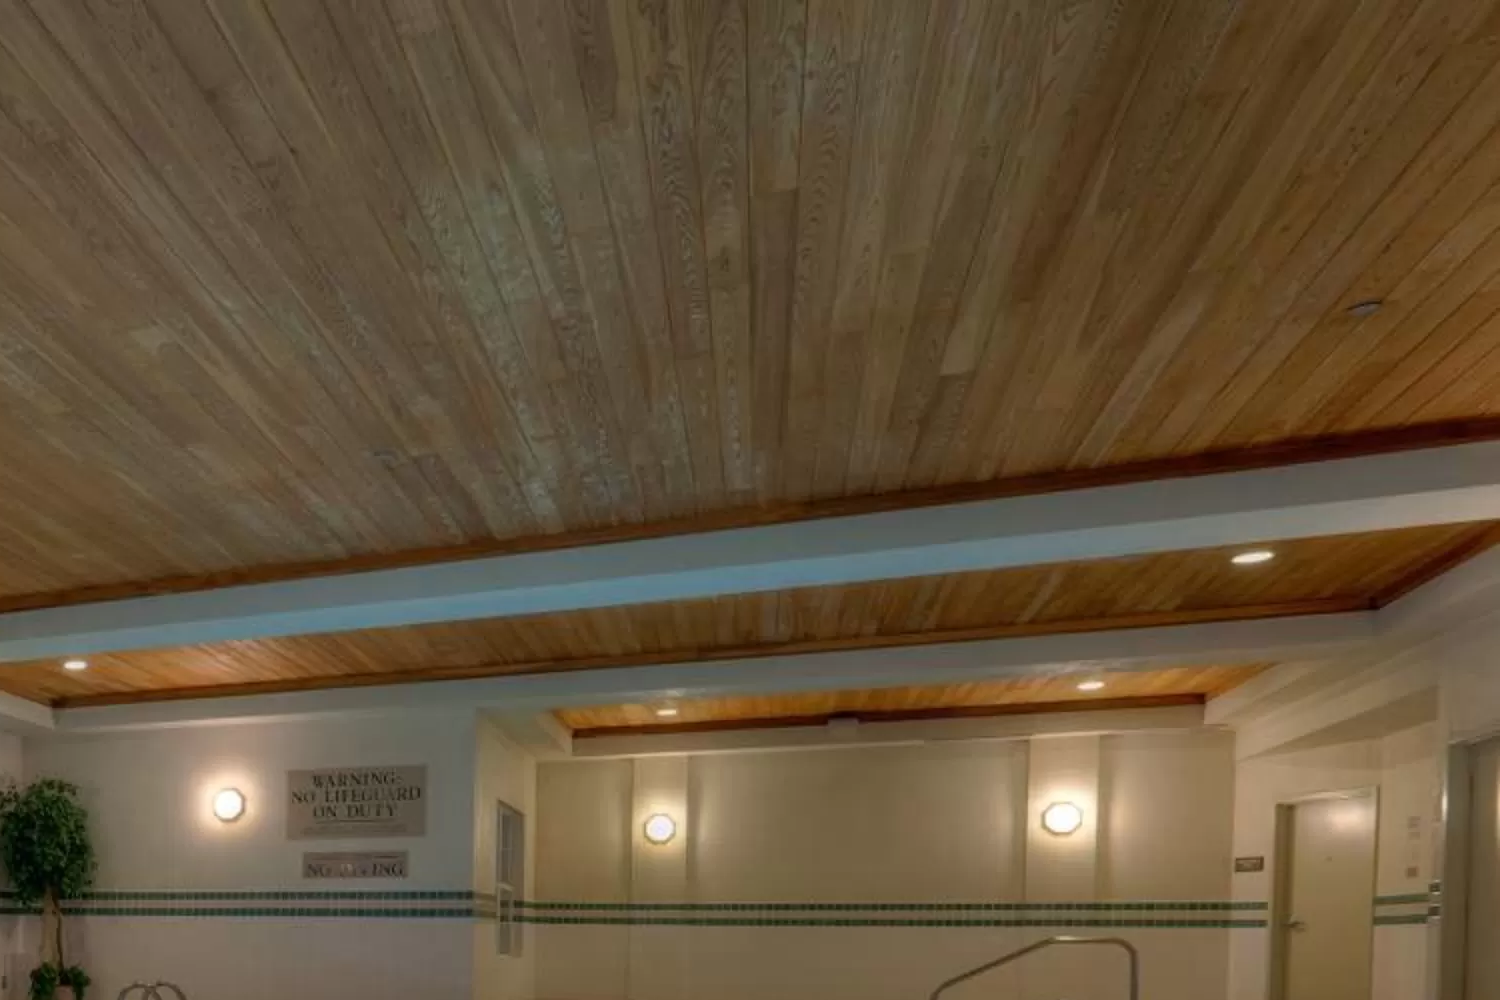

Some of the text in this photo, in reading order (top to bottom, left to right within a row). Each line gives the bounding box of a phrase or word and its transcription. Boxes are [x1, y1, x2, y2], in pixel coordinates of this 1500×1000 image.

[292, 786, 421, 804] NO LIFEGUARD
[313, 803, 398, 818] ON DUTY
[307, 863, 333, 877] NO
